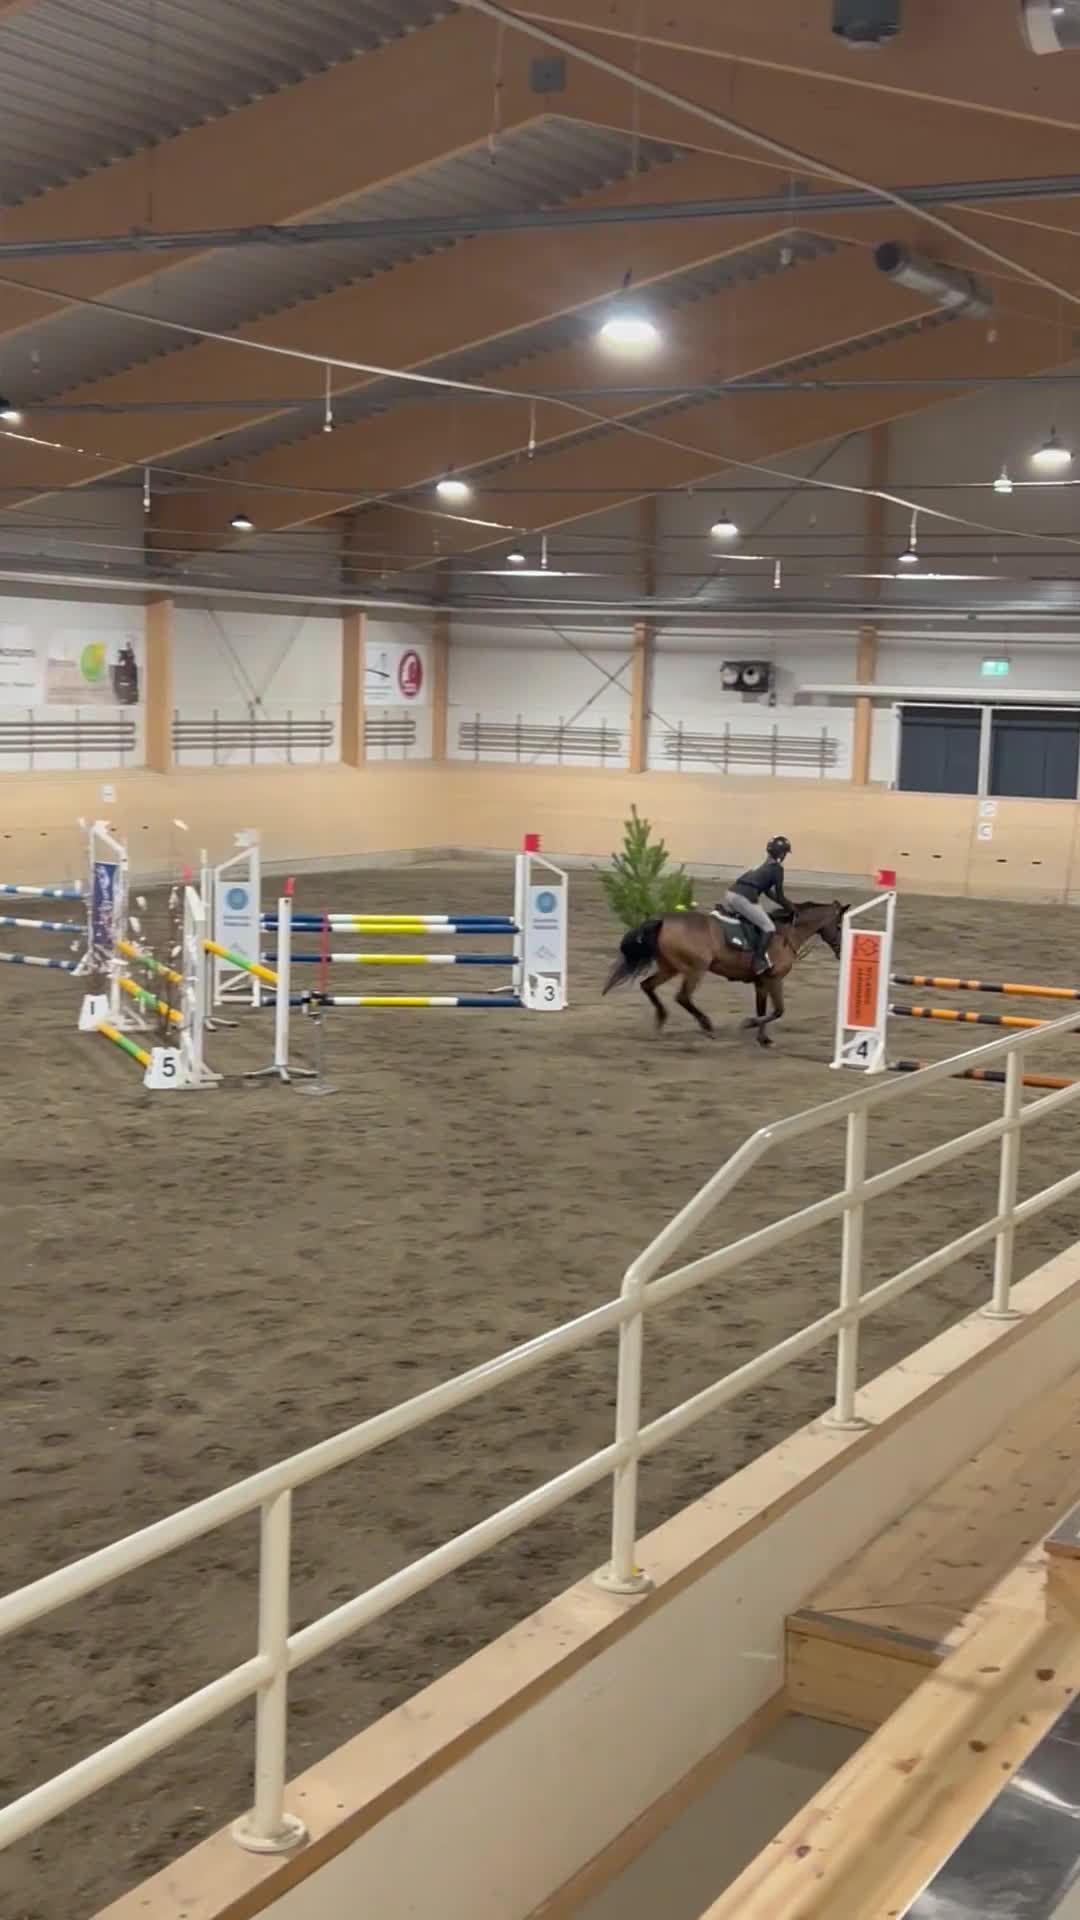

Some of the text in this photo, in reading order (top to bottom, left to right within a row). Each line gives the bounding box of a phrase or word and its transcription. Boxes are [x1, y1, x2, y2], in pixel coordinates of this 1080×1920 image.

[543, 985, 556, 1002] 3
[90, 1001, 95, 1015] 1
[856, 1040, 868, 1059] 4
[162, 1057, 176, 1078] 5
